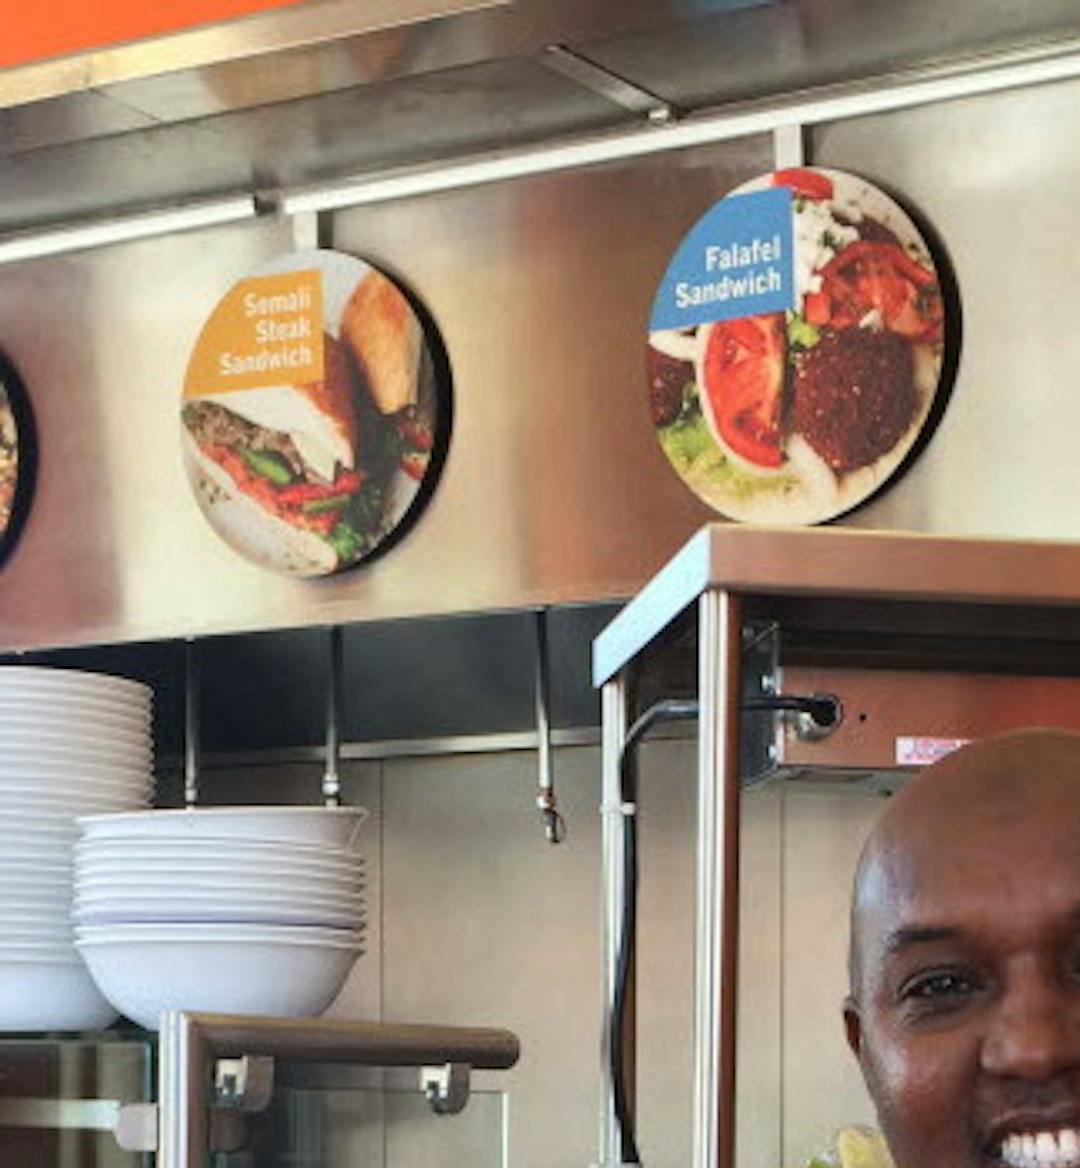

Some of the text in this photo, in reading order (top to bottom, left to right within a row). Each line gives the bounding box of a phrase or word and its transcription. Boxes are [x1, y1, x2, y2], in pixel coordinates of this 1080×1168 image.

[705, 234, 781, 272] Falafel
[243, 286, 311, 318] Somali
[674, 268, 782, 309] Sandwich
[256, 315, 311, 344] Steak
[218, 343, 312, 375] Sandwich
